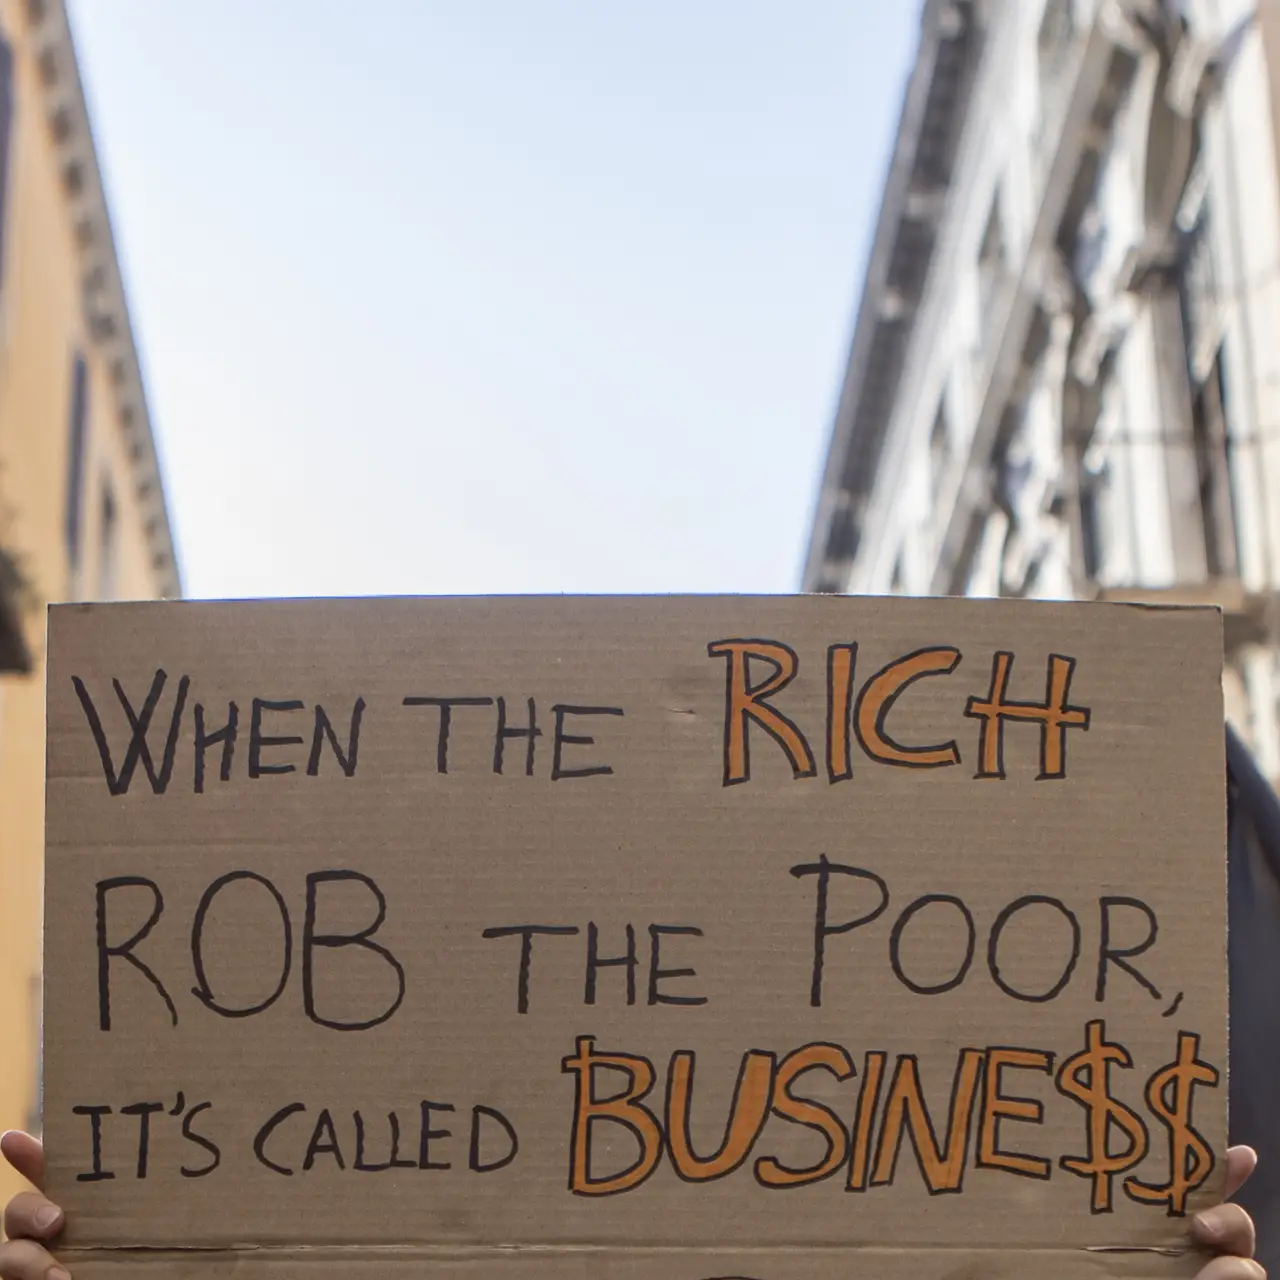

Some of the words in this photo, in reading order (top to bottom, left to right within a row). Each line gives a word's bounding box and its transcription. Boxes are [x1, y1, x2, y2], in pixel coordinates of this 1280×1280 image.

[71, 669, 366, 795] WHEN
[403, 695, 624, 778] THE
[708, 638, 1091, 785] RICH
[96, 869, 406, 1031] ROB
[482, 922, 710, 1014] THE
[789, 854, 1184, 1016] POOR,
[71, 1091, 221, 1183] IT'S
[254, 1101, 519, 1175] CALLED
